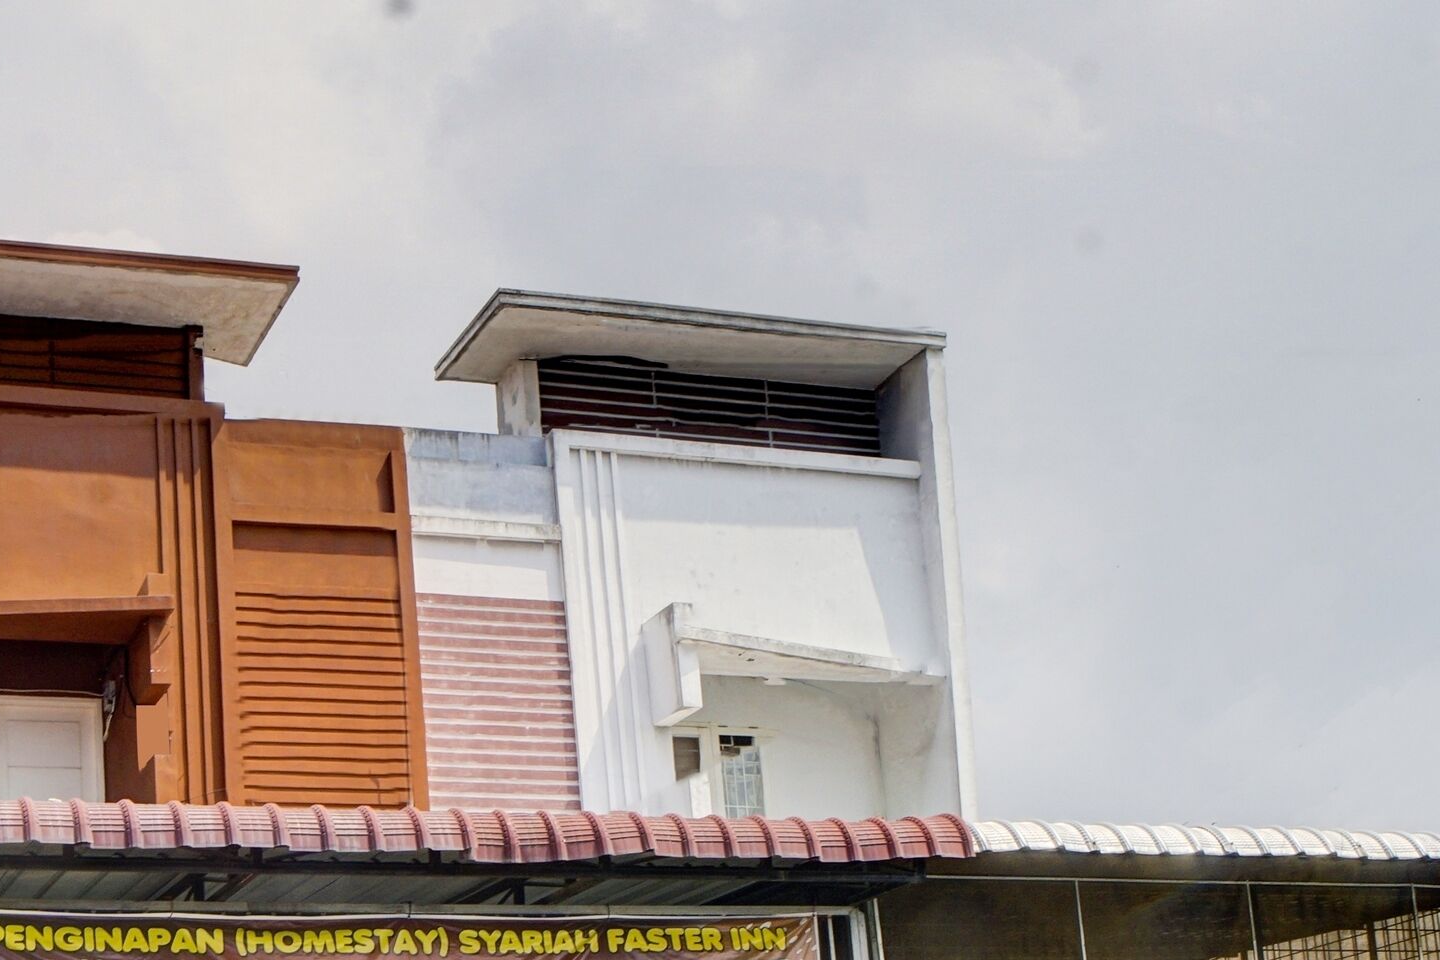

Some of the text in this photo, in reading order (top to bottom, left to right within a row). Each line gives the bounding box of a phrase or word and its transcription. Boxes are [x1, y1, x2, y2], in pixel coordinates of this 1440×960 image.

[235, 927, 449, 957] (HOMESTAY)
[459, 929, 599, 955] SYARIAH
[606, 927, 724, 953] FASTER
[730, 927, 787, 951] INN
